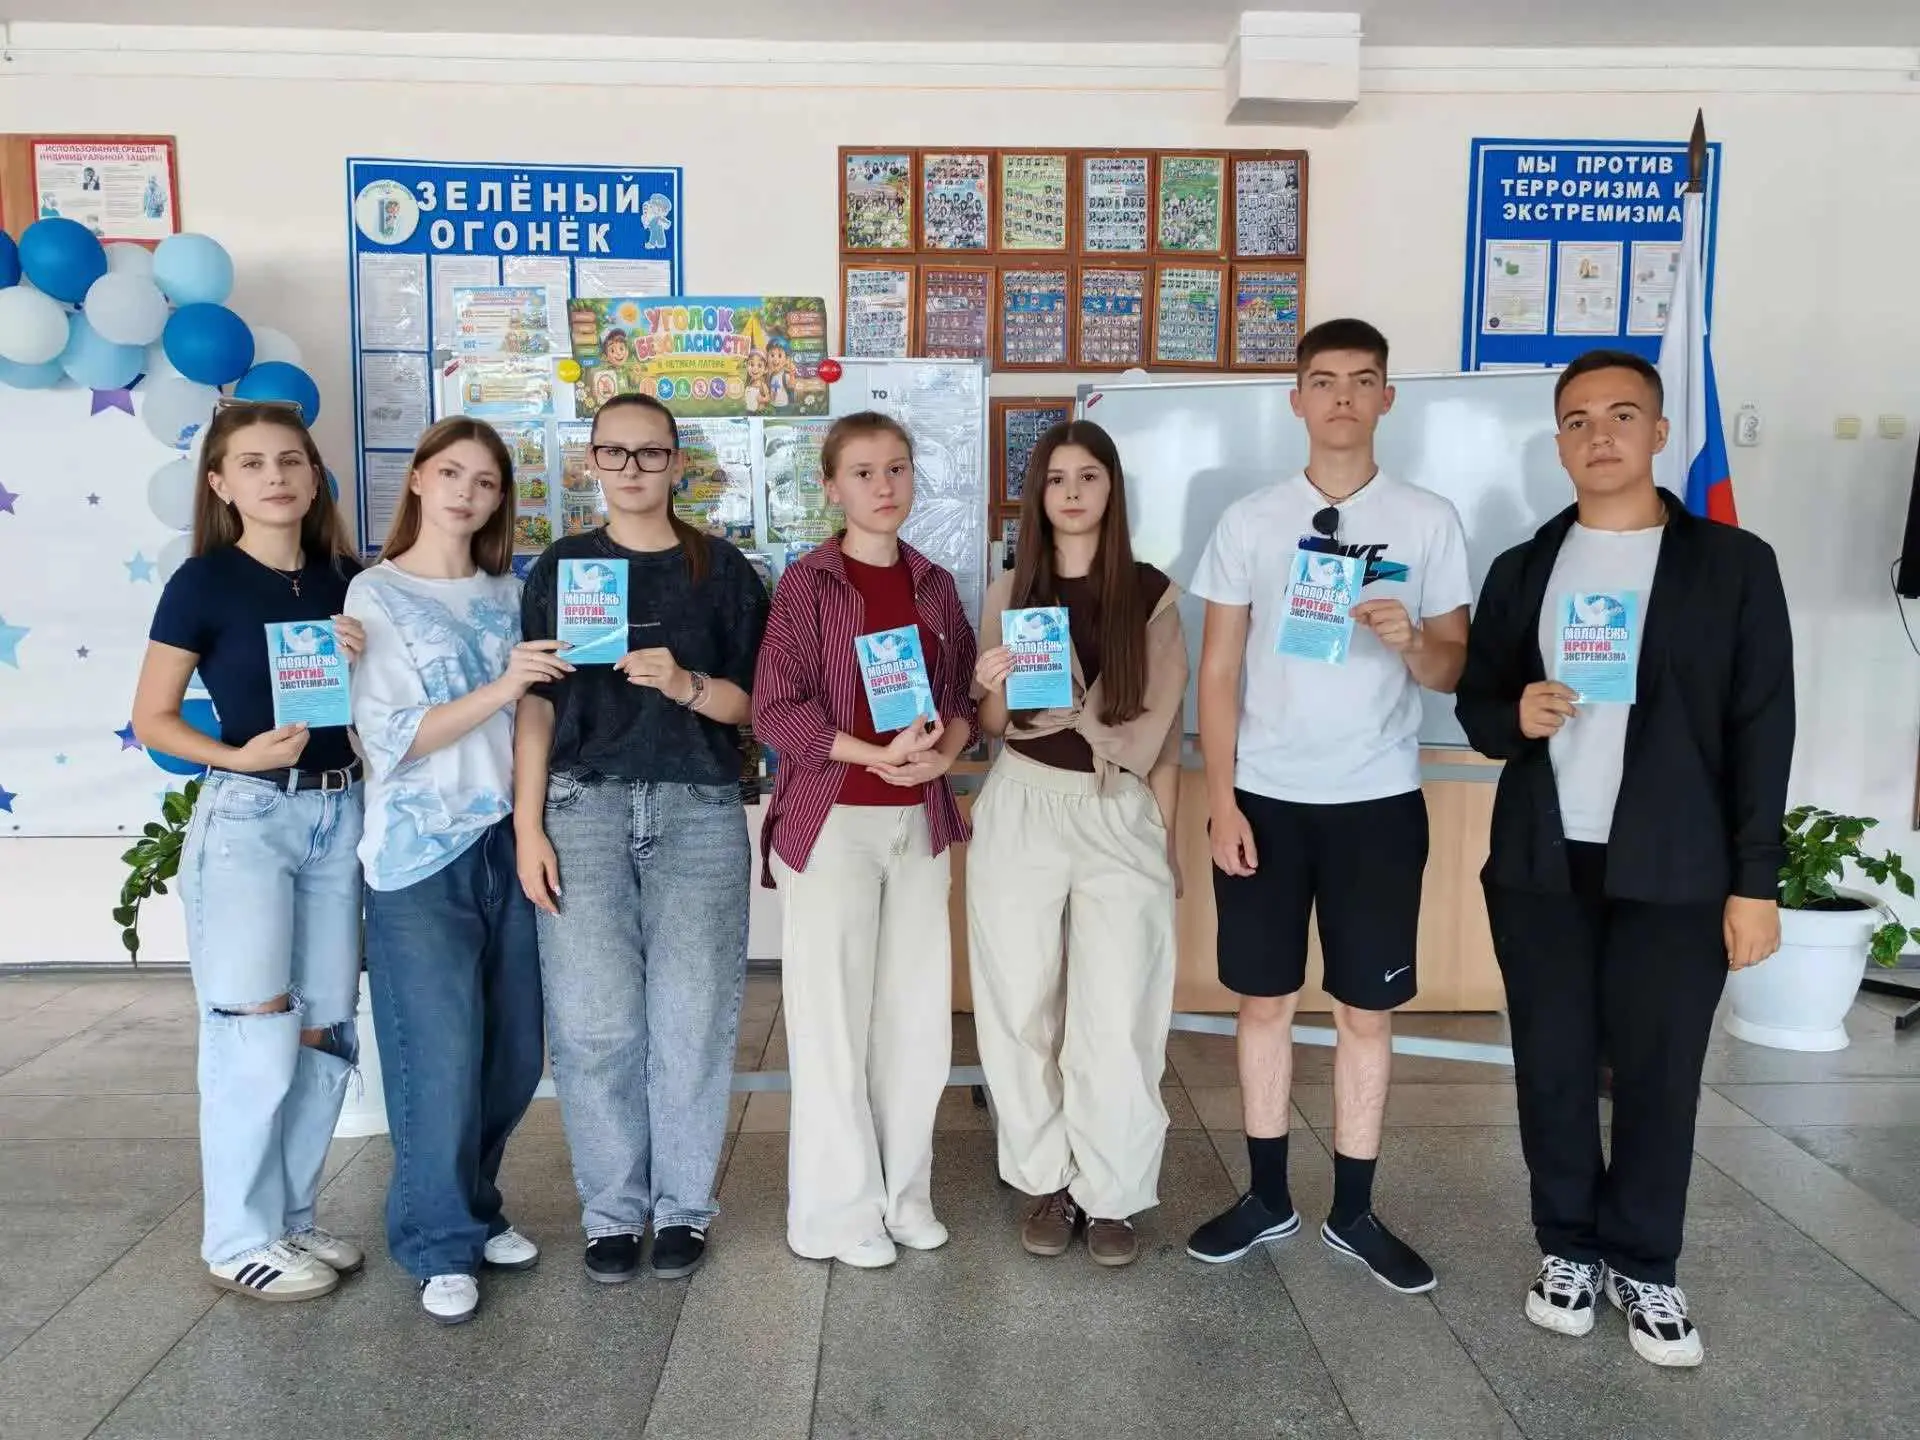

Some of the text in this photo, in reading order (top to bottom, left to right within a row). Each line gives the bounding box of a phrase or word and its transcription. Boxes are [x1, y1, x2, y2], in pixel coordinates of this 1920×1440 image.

[1517, 156, 1673, 174] МЫ ПРОТИВ
[416, 174, 640, 213] ЗЕЛЁНЫЙ
[1501, 179, 1661, 199] ТЕРРОРИЗМА
[1502, 203, 1682, 223] ЭКСТРЕМИЗМА
[430, 215, 611, 253] ОГОНЁК
[645, 306, 734, 334] УГОЛОК
